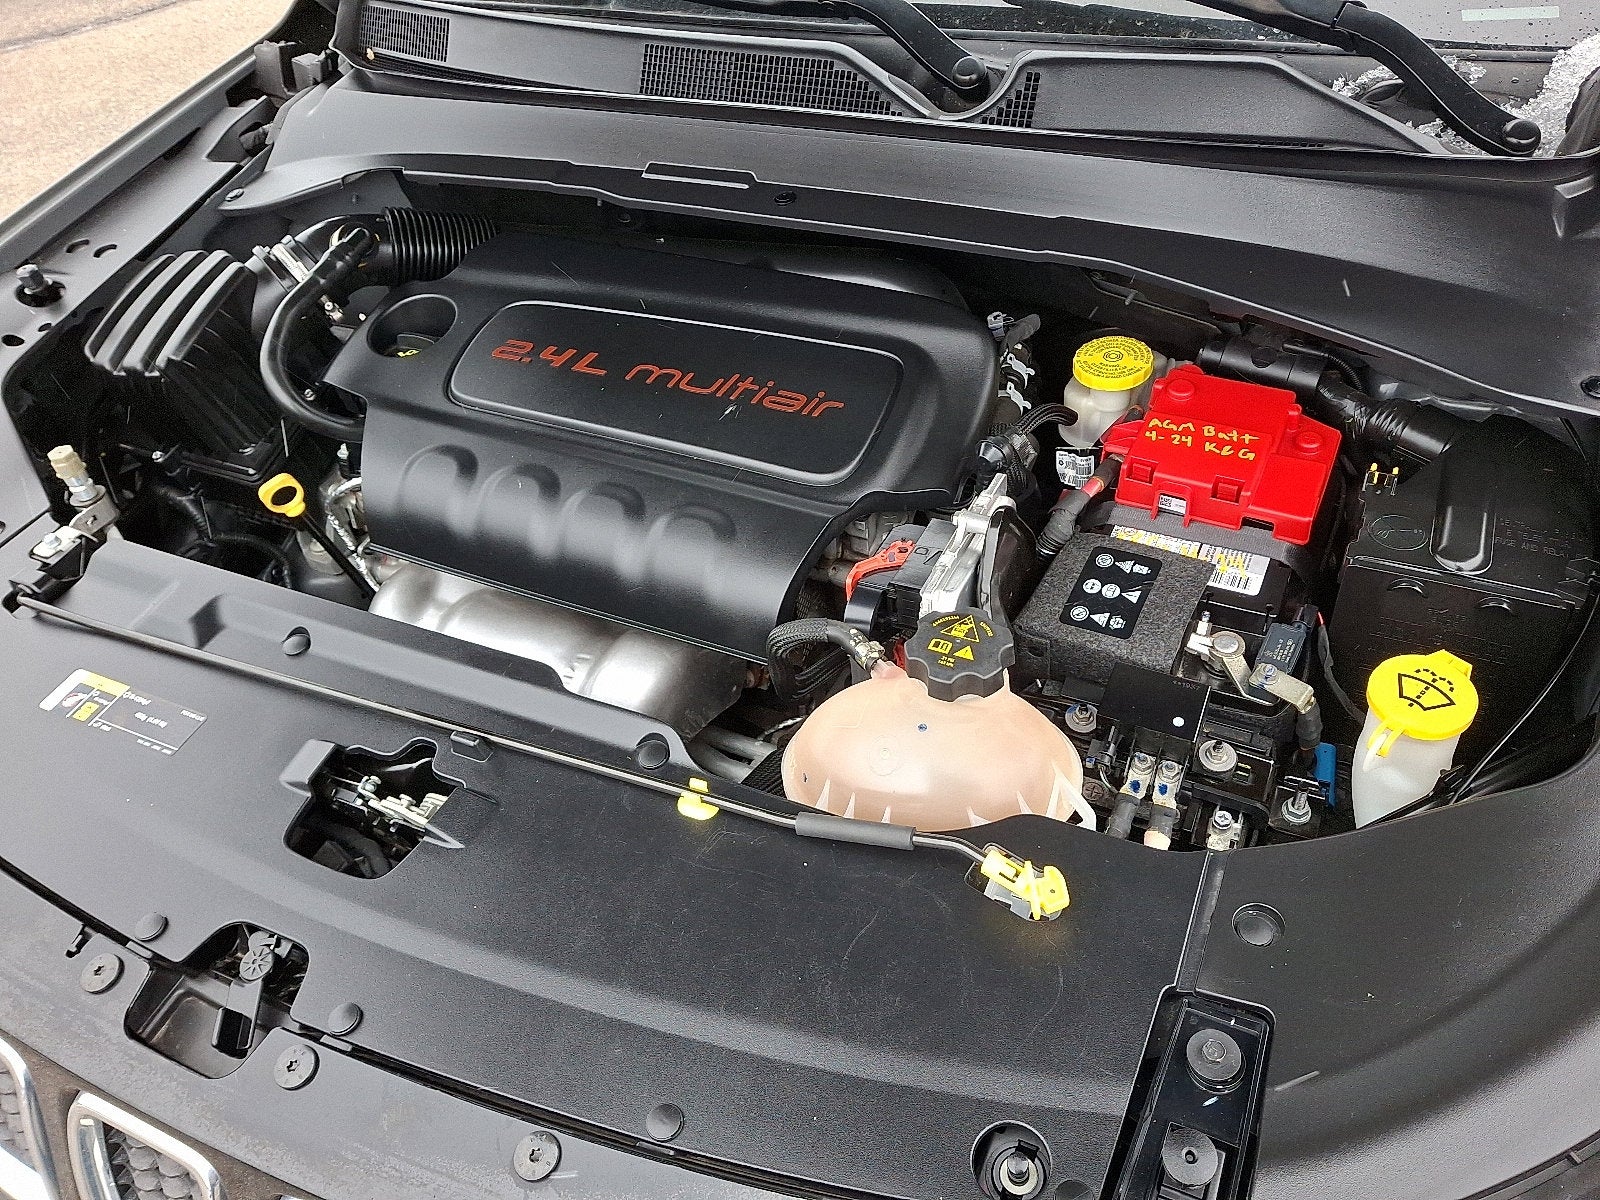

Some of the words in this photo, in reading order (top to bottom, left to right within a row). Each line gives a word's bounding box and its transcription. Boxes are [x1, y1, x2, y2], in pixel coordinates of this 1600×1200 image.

[491, 339, 608, 376] 2.4L
[624, 362, 845, 417] multiair
[1148, 418, 1196, 432] AGM
[1202, 425, 1261, 445] Batt
